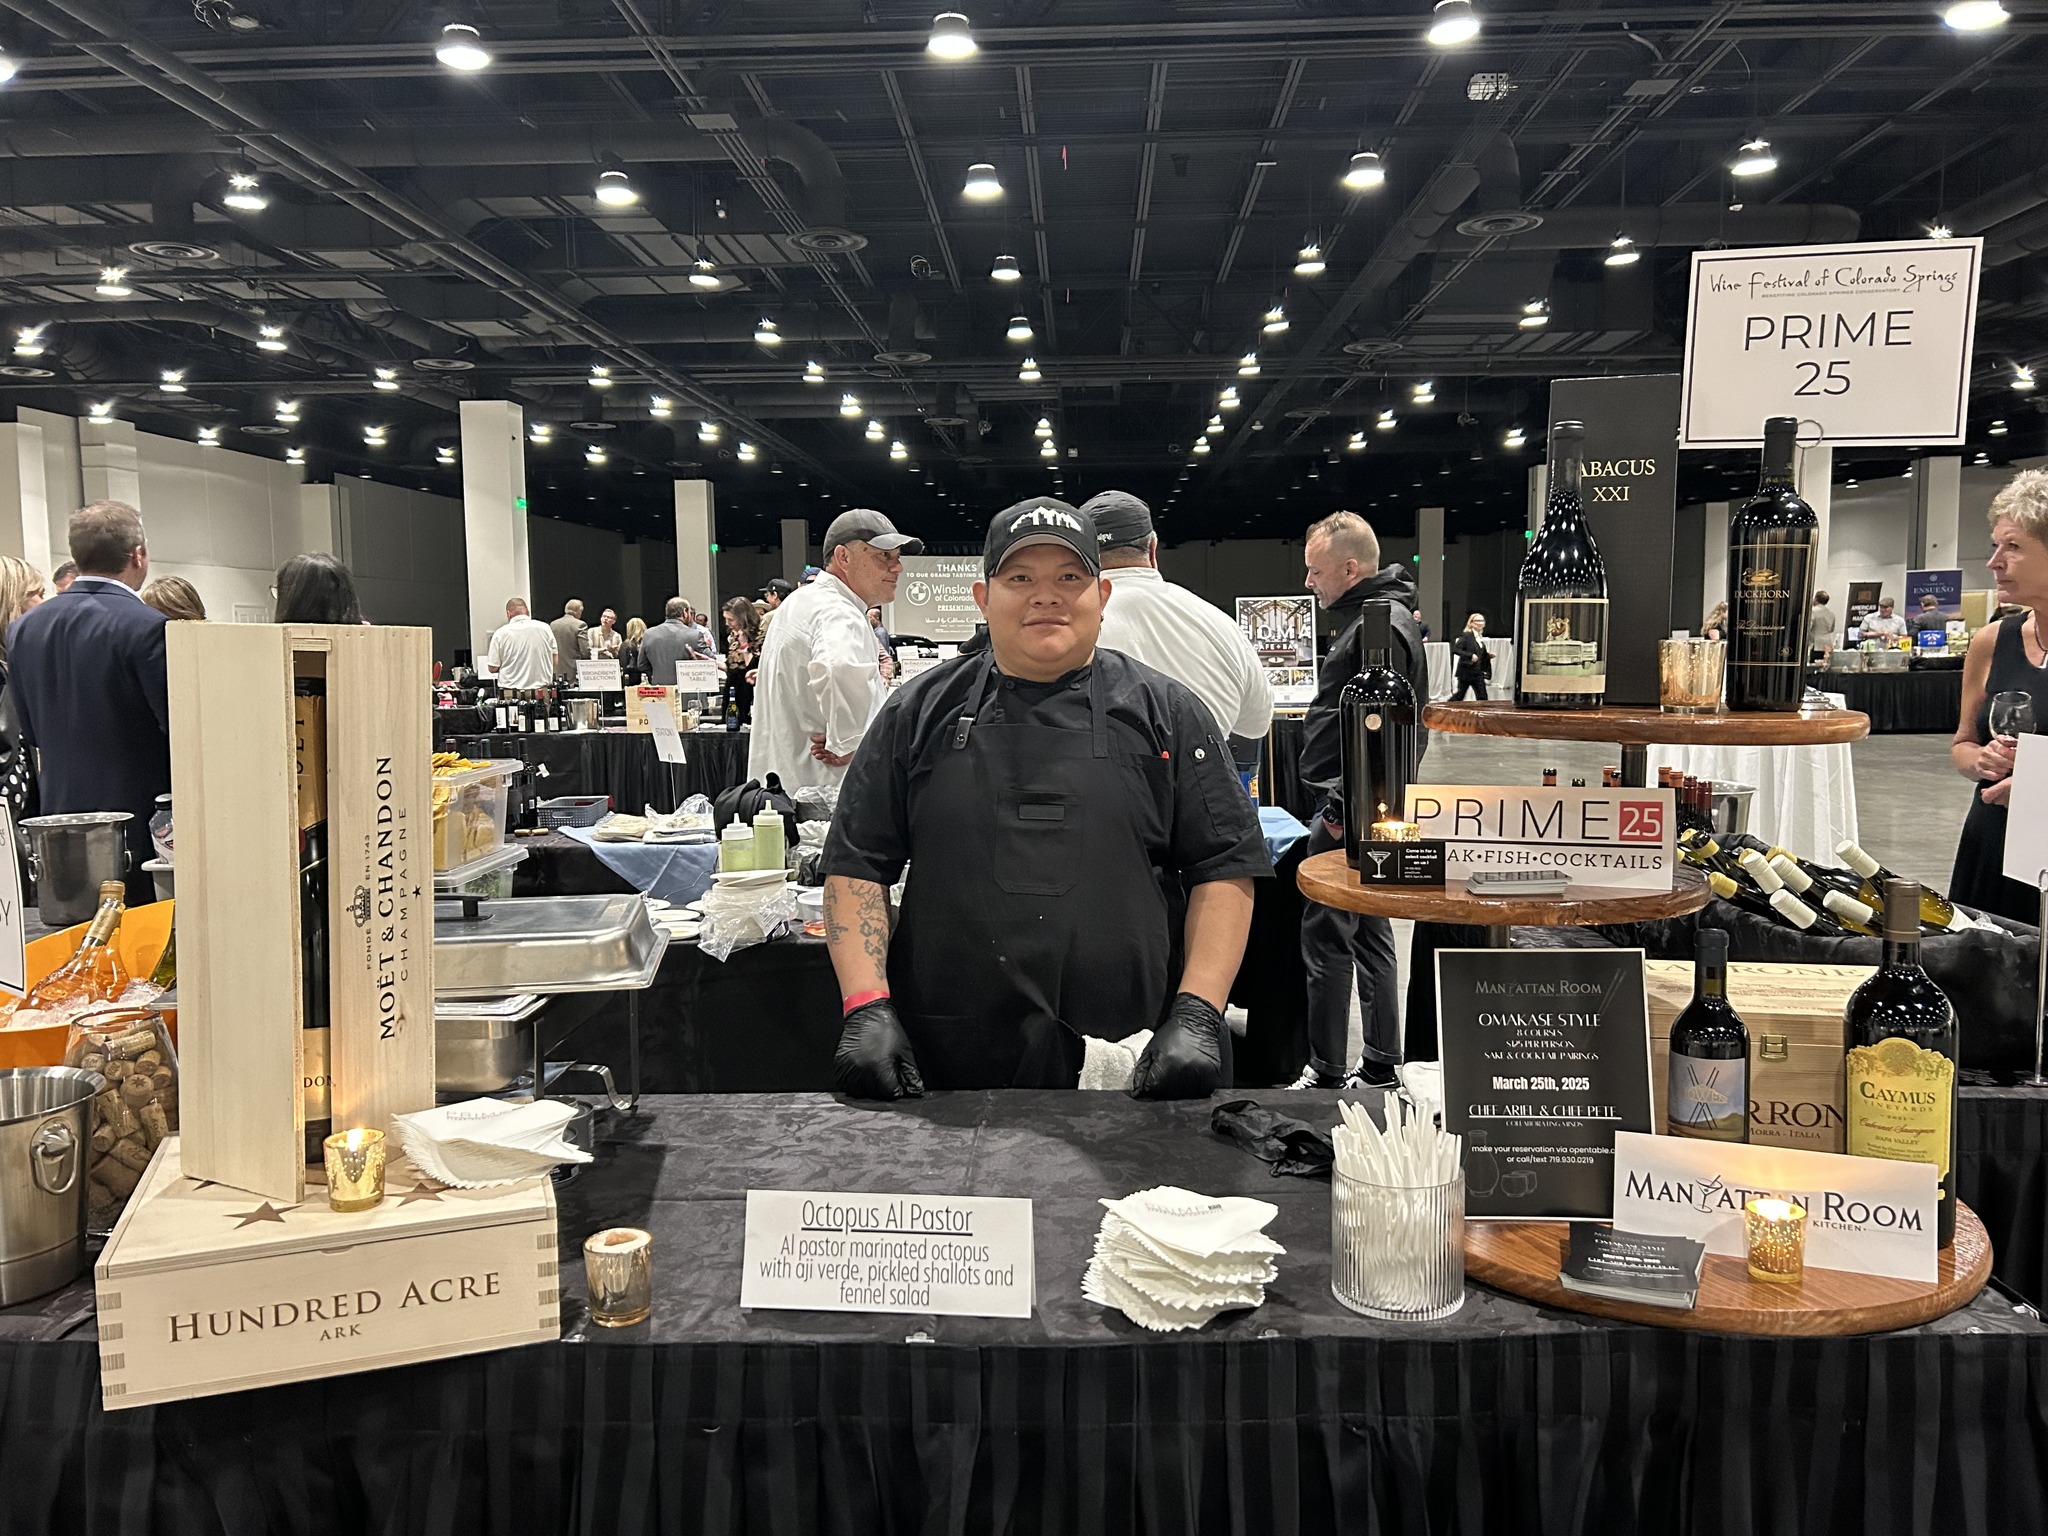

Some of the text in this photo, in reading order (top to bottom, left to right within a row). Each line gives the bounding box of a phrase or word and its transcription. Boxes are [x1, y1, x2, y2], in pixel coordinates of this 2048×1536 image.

[1710, 264, 1958, 300] Wine Festival of Colorado Springs
[1744, 310, 1914, 351] PRIME
[1794, 360, 1851, 396] 25
[1592, 486, 1630, 502] XXI
[936, 564, 977, 572] THANKS
[1734, 589, 1790, 599] DUCKHORN
[1914, 585, 1954, 594] ENSUEÑO
[1413, 798, 1662, 840] PRIME 25
[365, 865, 370, 880] EN
[376, 757, 395, 1041] MOËT & CHANDON
[398, 808, 409, 981] CHAMPAGNE
[1560, 980, 1602, 994] ROOM
[1478, 1013, 1601, 1027] OMAKASE STYLE
[1492, 1076, 1590, 1092] March 25th, 2025
[1860, 1081, 1936, 1105] CAYMUS
[1469, 1104, 1498, 1116] CHEF
[1539, 1105, 1549, 1116] &
[1552, 1105, 1584, 1116] CHEF
[1863, 1100, 1934, 1112] VINEYARDS
[1875, 1135, 1892, 1143] NAPA
[1471, 1145, 1493, 1153] make
[1493, 1146, 1511, 1154] your
[1512, 1145, 1555, 1153] reservation
[1516, 1155, 1547, 1163] call/text
[1549, 1156, 1594, 1164] 719.930.0219
[802, 1200, 973, 1235] Octopus Al Pastor
[1824, 1191, 1923, 1231] ROOM
[1812, 1220, 1862, 1232] KITCHEN
[781, 1234, 989, 1270] Al pastor marinated octopus
[760, 1257, 1013, 1286] with aji verde, pickled shallots and
[840, 1281, 930, 1306] fennel salad
[168, 1271, 501, 1344] HUNDRED ACRE
[319, 1323, 363, 1342] ARK
